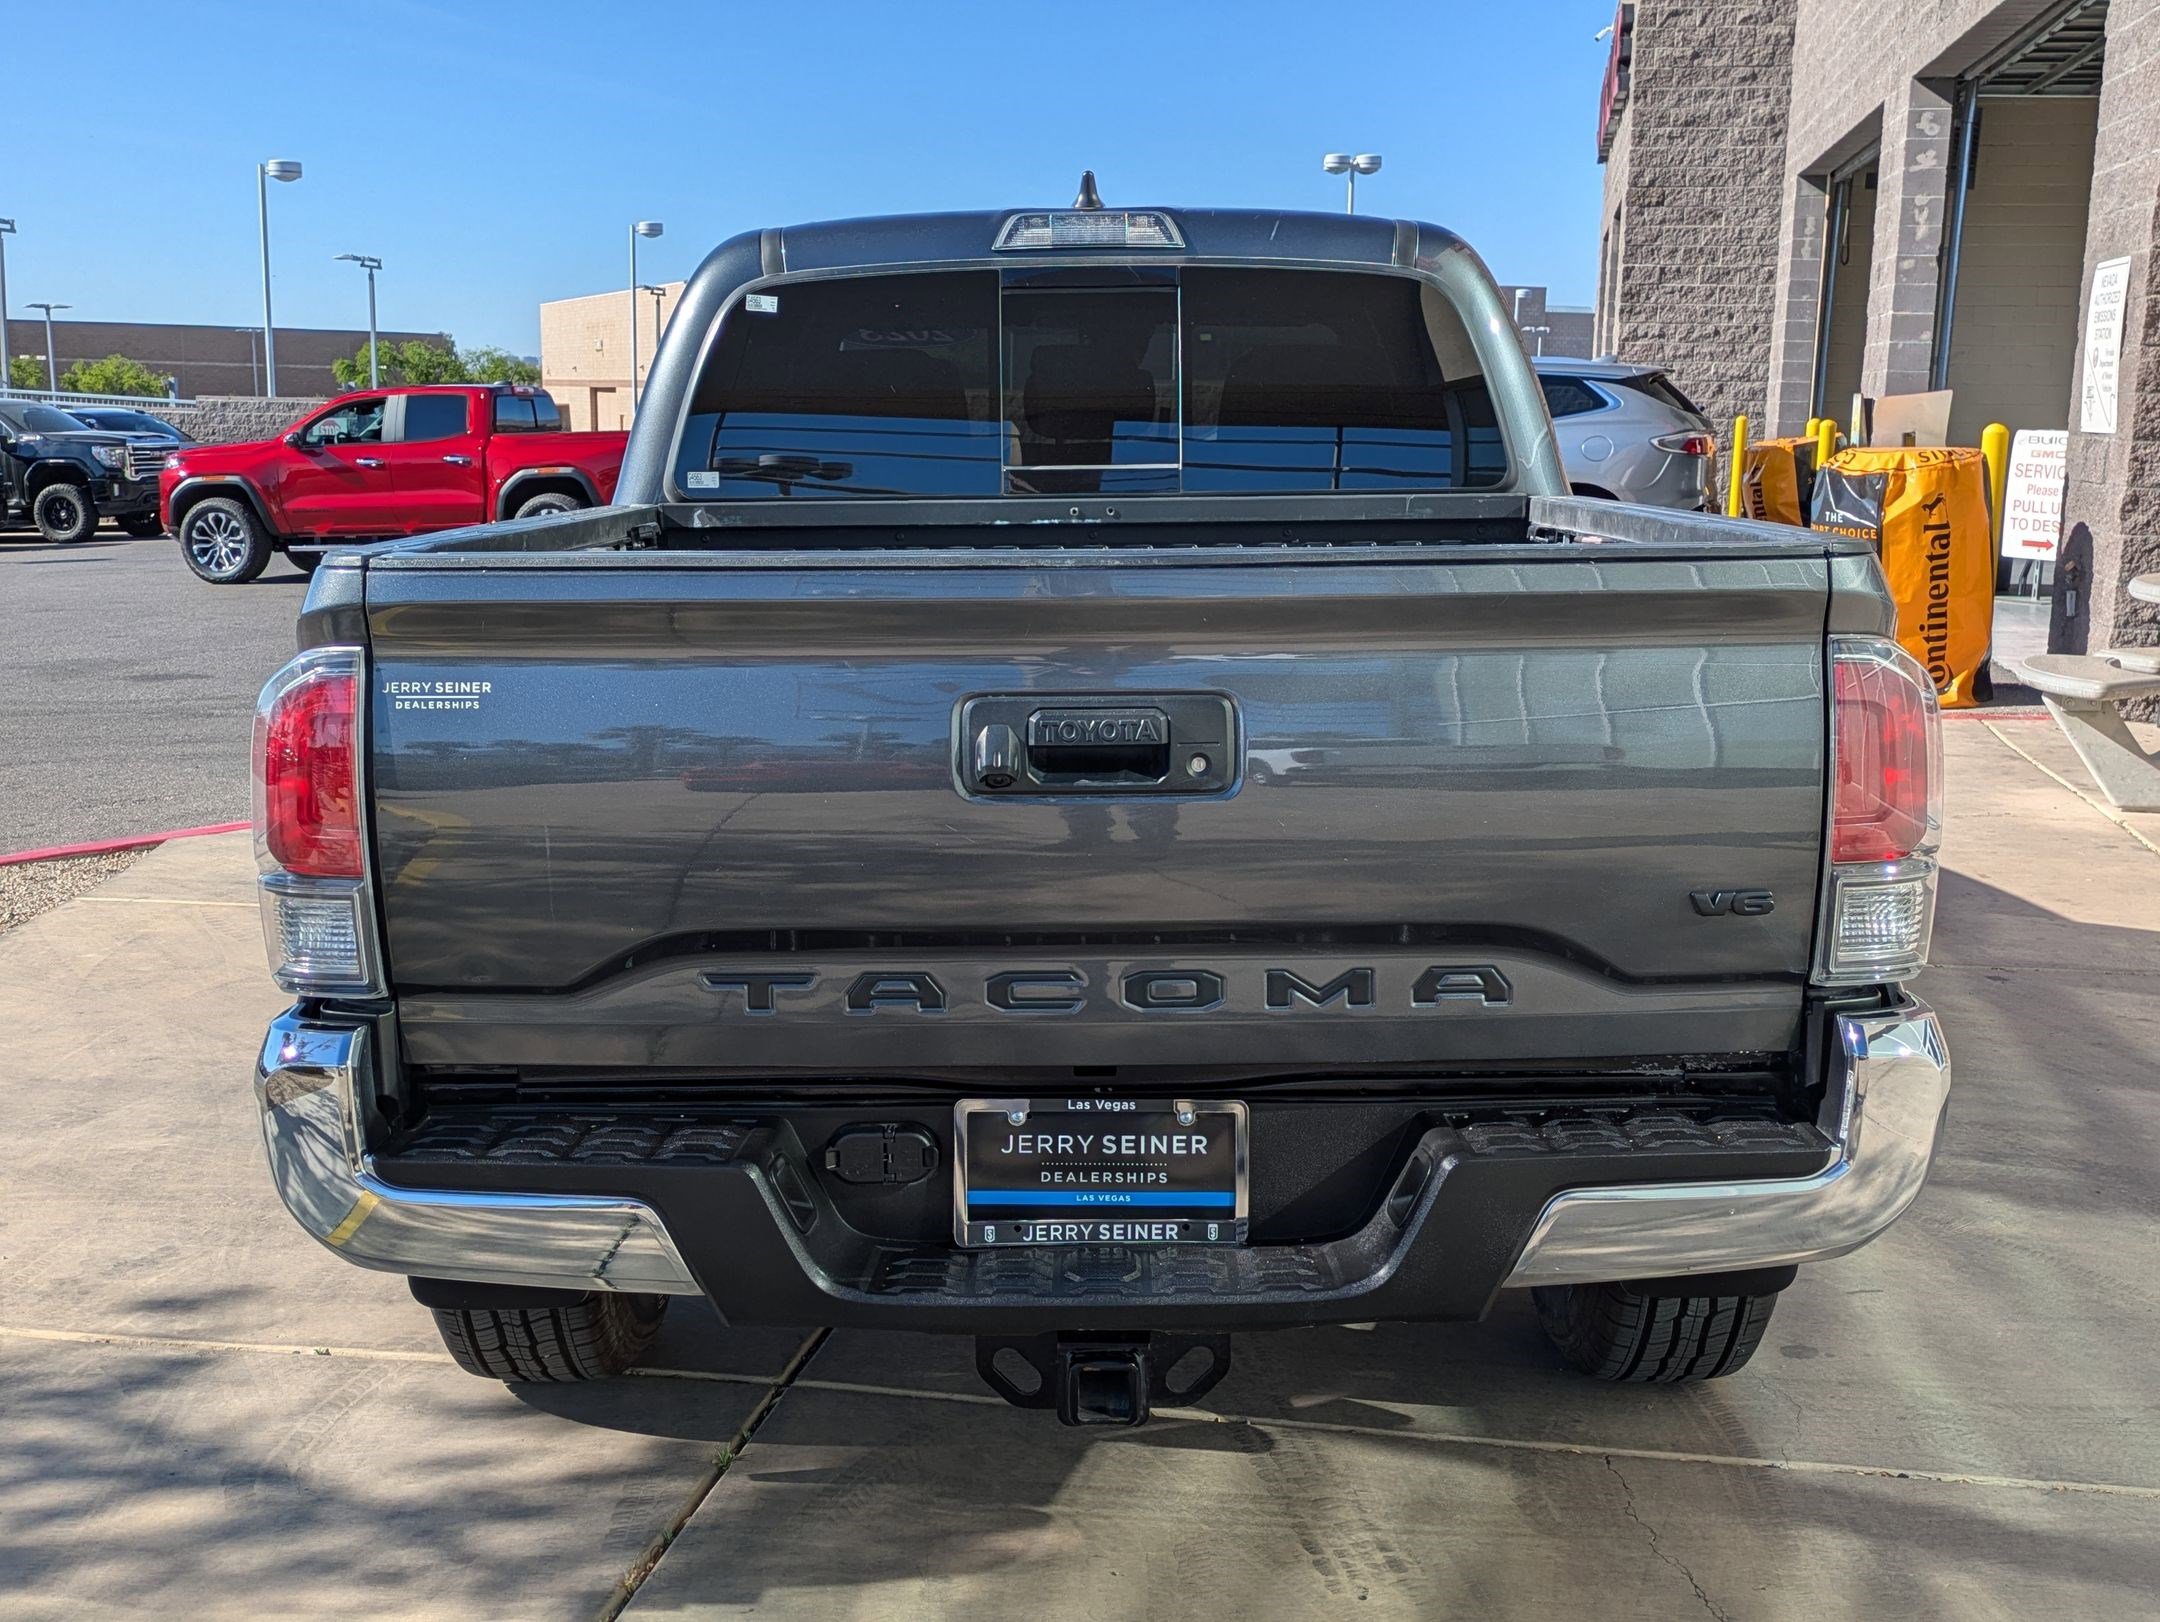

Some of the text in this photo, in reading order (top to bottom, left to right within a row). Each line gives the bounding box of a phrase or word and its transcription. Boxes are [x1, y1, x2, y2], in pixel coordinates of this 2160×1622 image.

[2028, 435, 2068, 446] BUIC
[2015, 463, 2066, 480] SERVIC
[2026, 483, 2059, 496] Please
[2013, 499, 2061, 515] PULL U
[1825, 511, 1844, 523] THE
[2010, 516, 2062, 533] TO DES
[1832, 527, 1877, 540] CHOICE
[382, 681, 492, 694] JERRY SEINER
[395, 700, 480, 710] DEALERSHIPS
[1040, 718, 1159, 744] TOYOTA
[1689, 888, 1775, 917] V6
[699, 965, 1513, 1017] TACOMA
[1067, 1099, 1137, 1112] Las Vegas
[1000, 1134, 1208, 1155] JERRY SEINER
[1040, 1171, 1168, 1184] DEALERSHIPS
[1076, 1194, 1131, 1203] LAS VEGAS
[1023, 1223, 1179, 1242] JERRY SEINER
